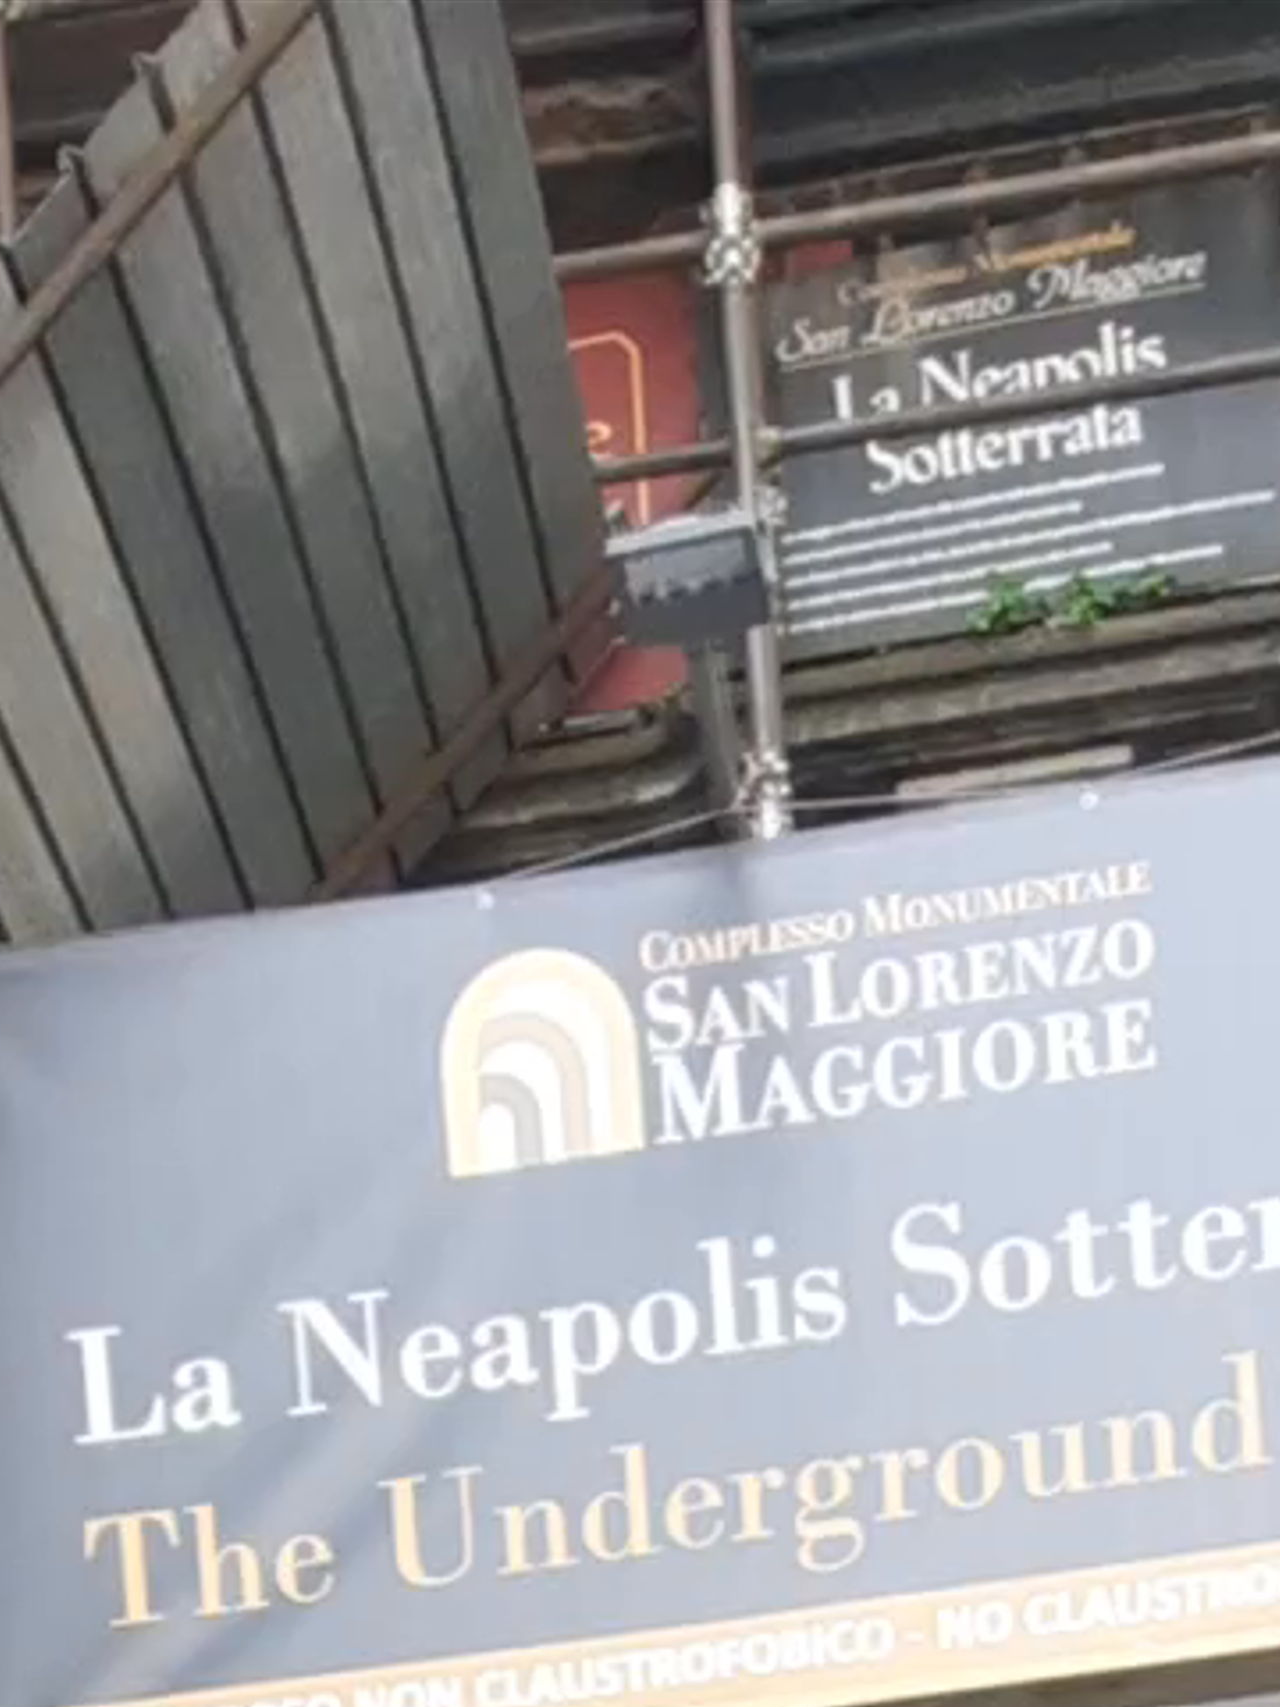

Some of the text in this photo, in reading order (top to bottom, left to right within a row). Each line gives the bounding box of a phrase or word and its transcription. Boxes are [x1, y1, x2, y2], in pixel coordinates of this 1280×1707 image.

[776, 250, 1207, 362] San Lorenzo Maggiore
[867, 404, 1142, 494] Sotterrata
[640, 861, 1150, 972] COMPLESSO MONUMENTALE
[643, 918, 1156, 1052] SAN LORENZO
[652, 998, 1156, 1144] MAGGIORE
[65, 1326, 242, 1446] La
[278, 1235, 847, 1422] Neapolis
[83, 1504, 336, 1627] The
[377, 1348, 1274, 1589] Underground
[938, 1598, 1013, 1651] NO
